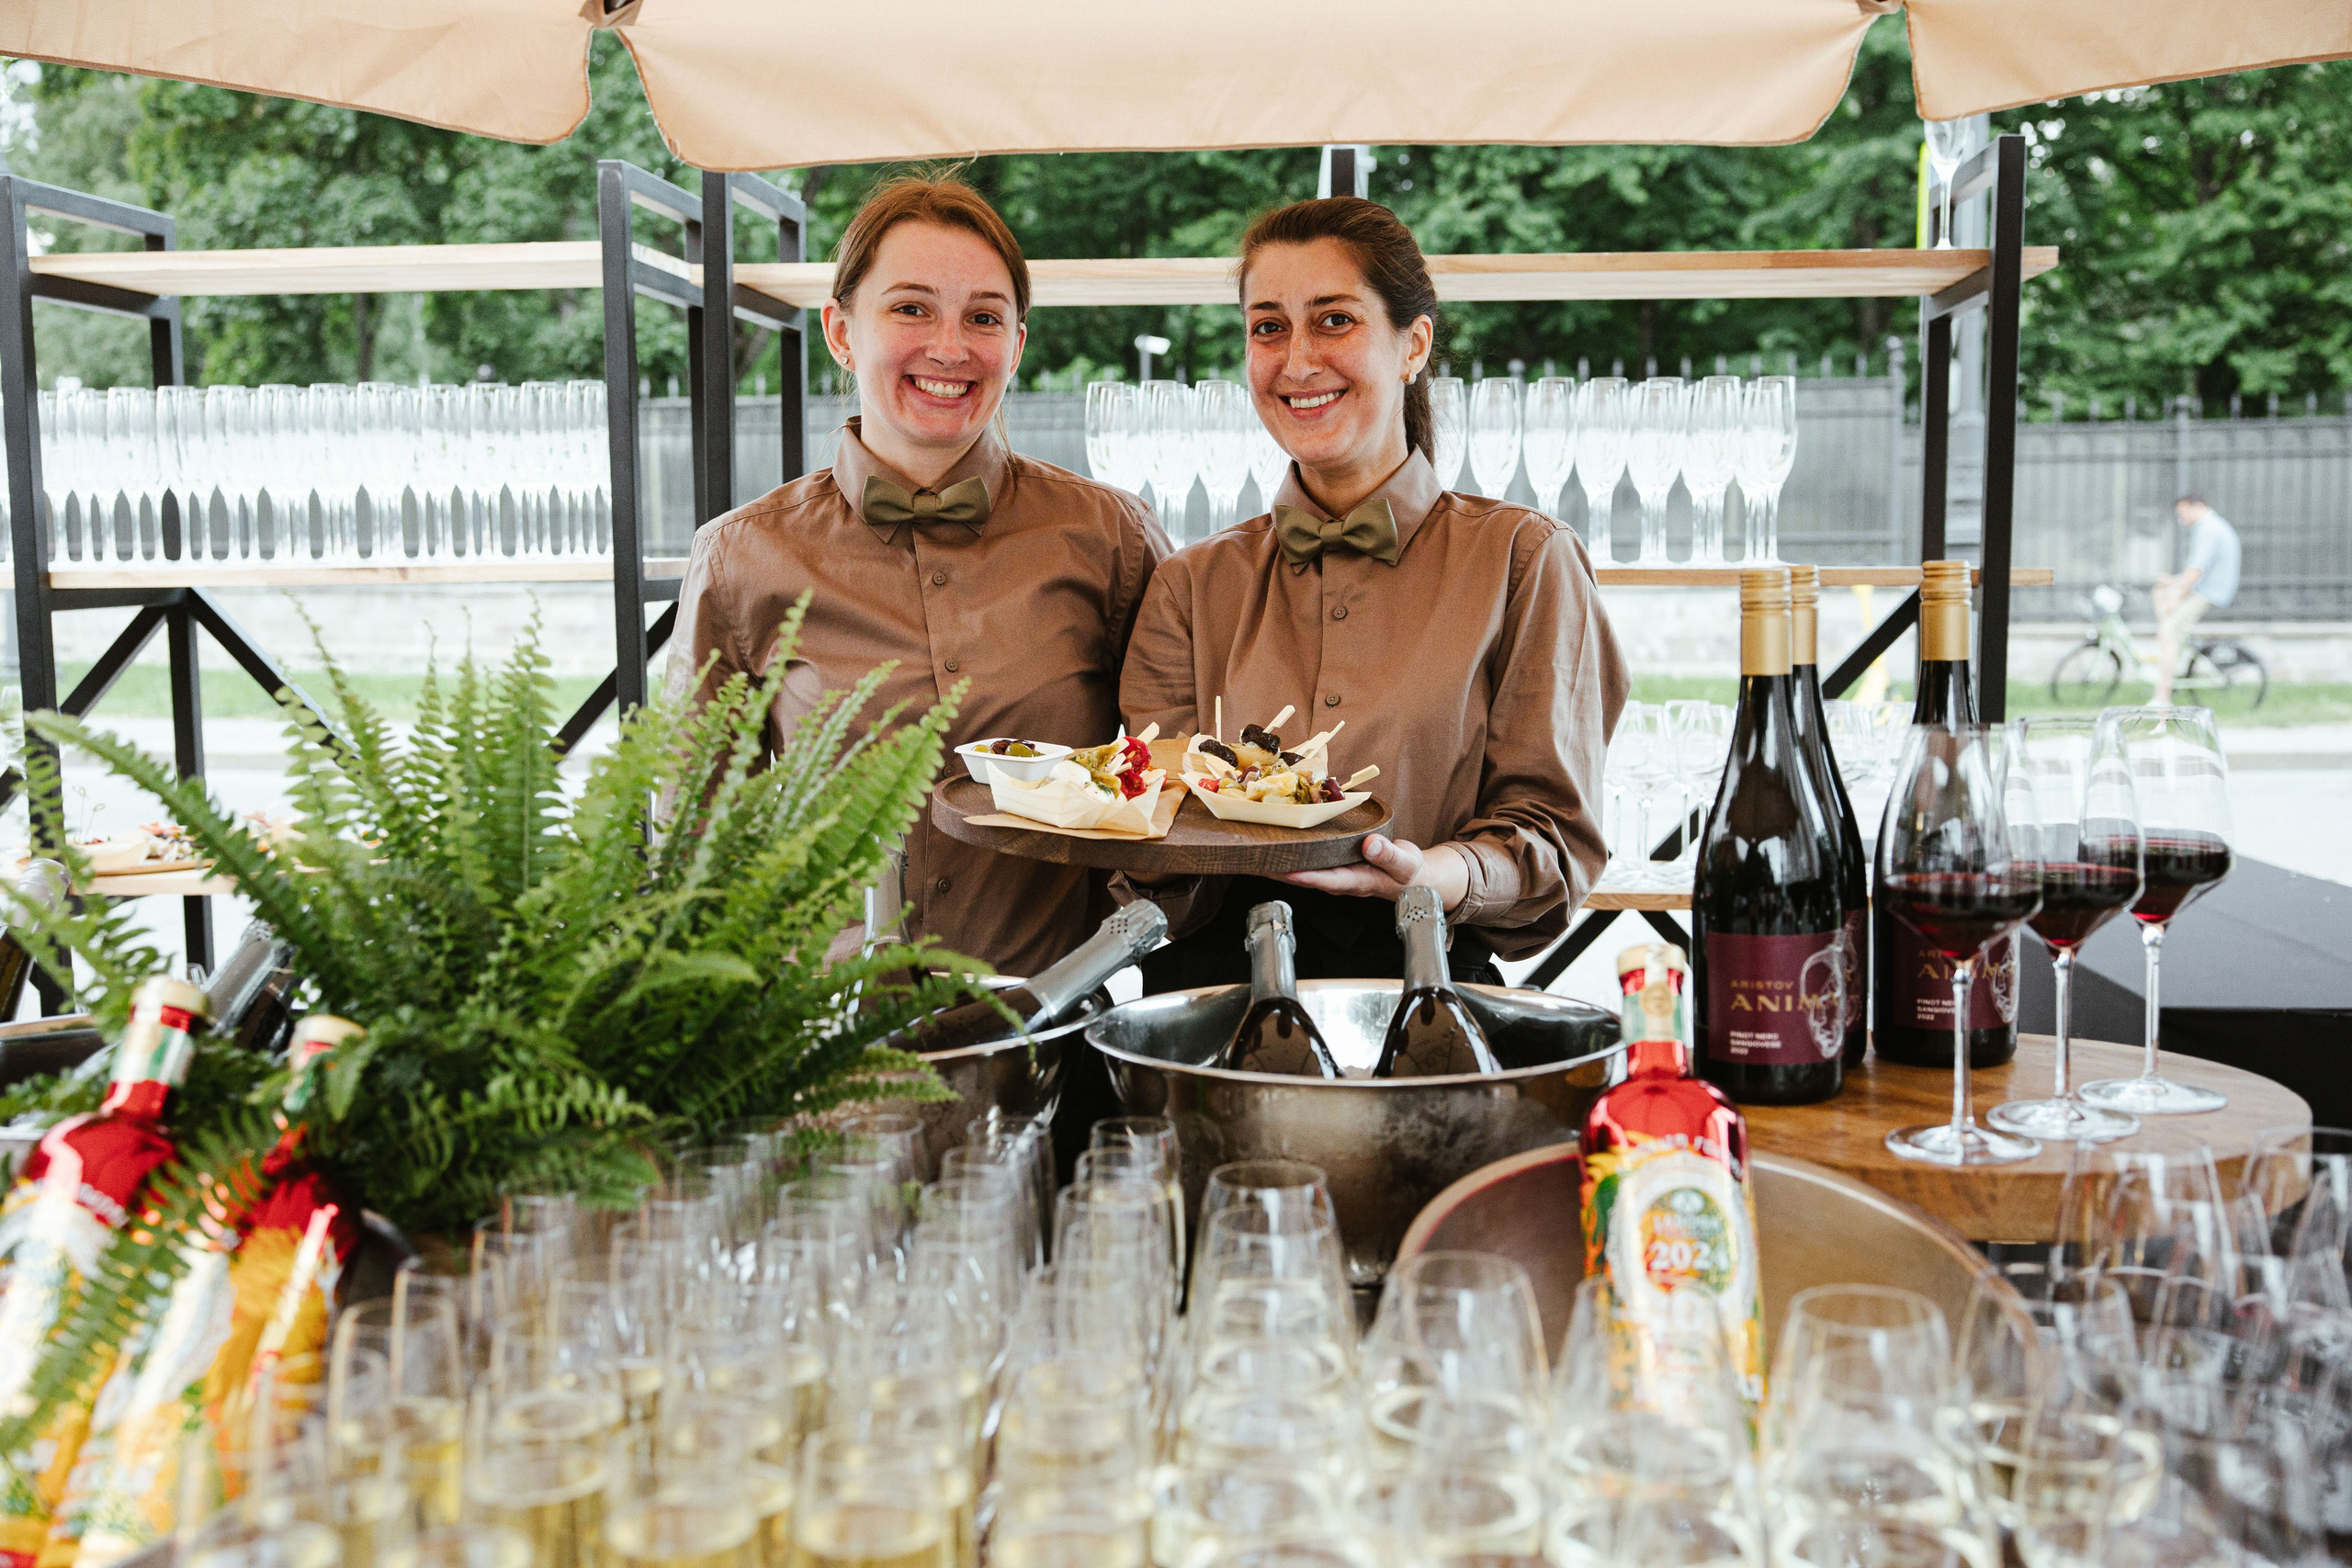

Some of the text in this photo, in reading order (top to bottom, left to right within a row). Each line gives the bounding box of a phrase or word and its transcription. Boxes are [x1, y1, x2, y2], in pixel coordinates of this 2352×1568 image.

[1730, 979, 1793, 990] ARISTOV
[1730, 1031, 1780, 1040] PINOT NERO
[1730, 1039, 1781, 1049] SANGIOVESE
